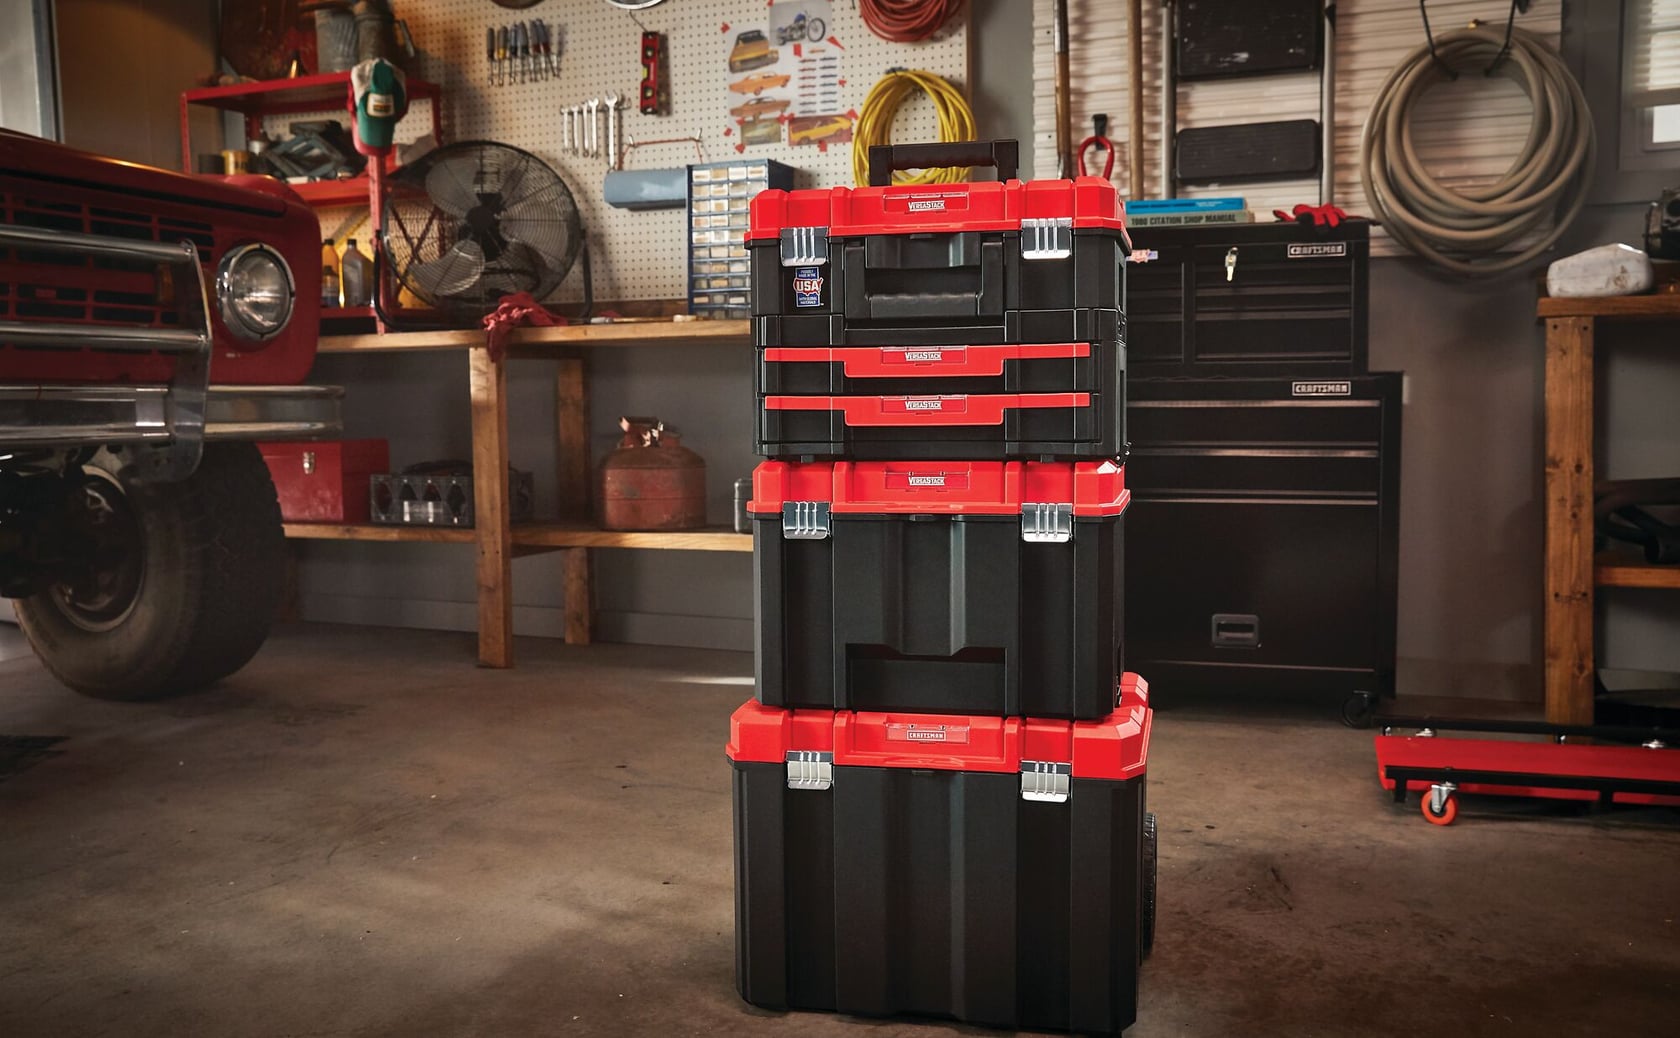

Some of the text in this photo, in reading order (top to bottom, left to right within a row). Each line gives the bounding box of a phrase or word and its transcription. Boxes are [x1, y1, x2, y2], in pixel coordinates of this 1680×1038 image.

[1149, 215, 1182, 225] CITATION
[1183, 214, 1204, 224] SHOP
[1205, 213, 1236, 223] MANUAL
[1290, 245, 1343, 254] CRAFTSMAN
[796, 280, 819, 291] USA
[1295, 385, 1348, 393] CRAFTSMAN
